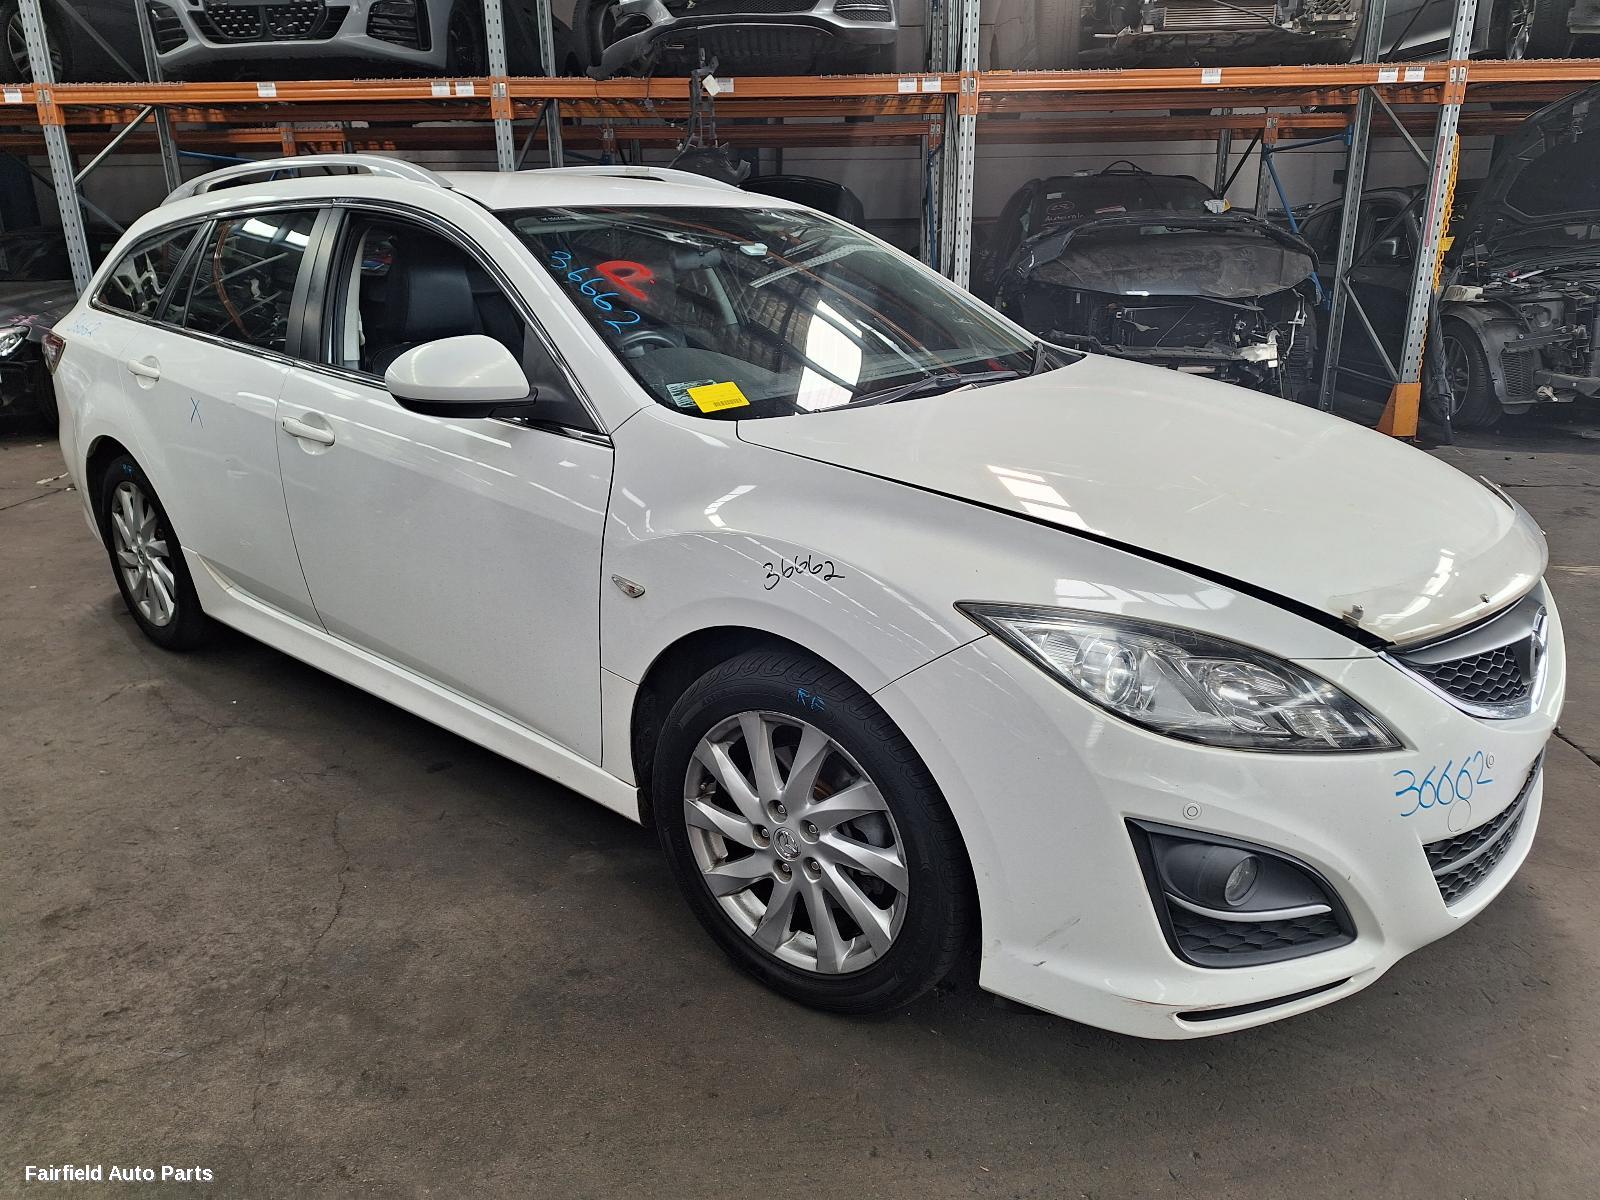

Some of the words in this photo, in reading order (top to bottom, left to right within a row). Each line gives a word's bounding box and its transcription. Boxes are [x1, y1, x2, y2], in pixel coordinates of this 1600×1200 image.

[549, 250, 641, 334] 36662
[763, 554, 846, 591] 36662
[1393, 750, 1494, 817] 36662
